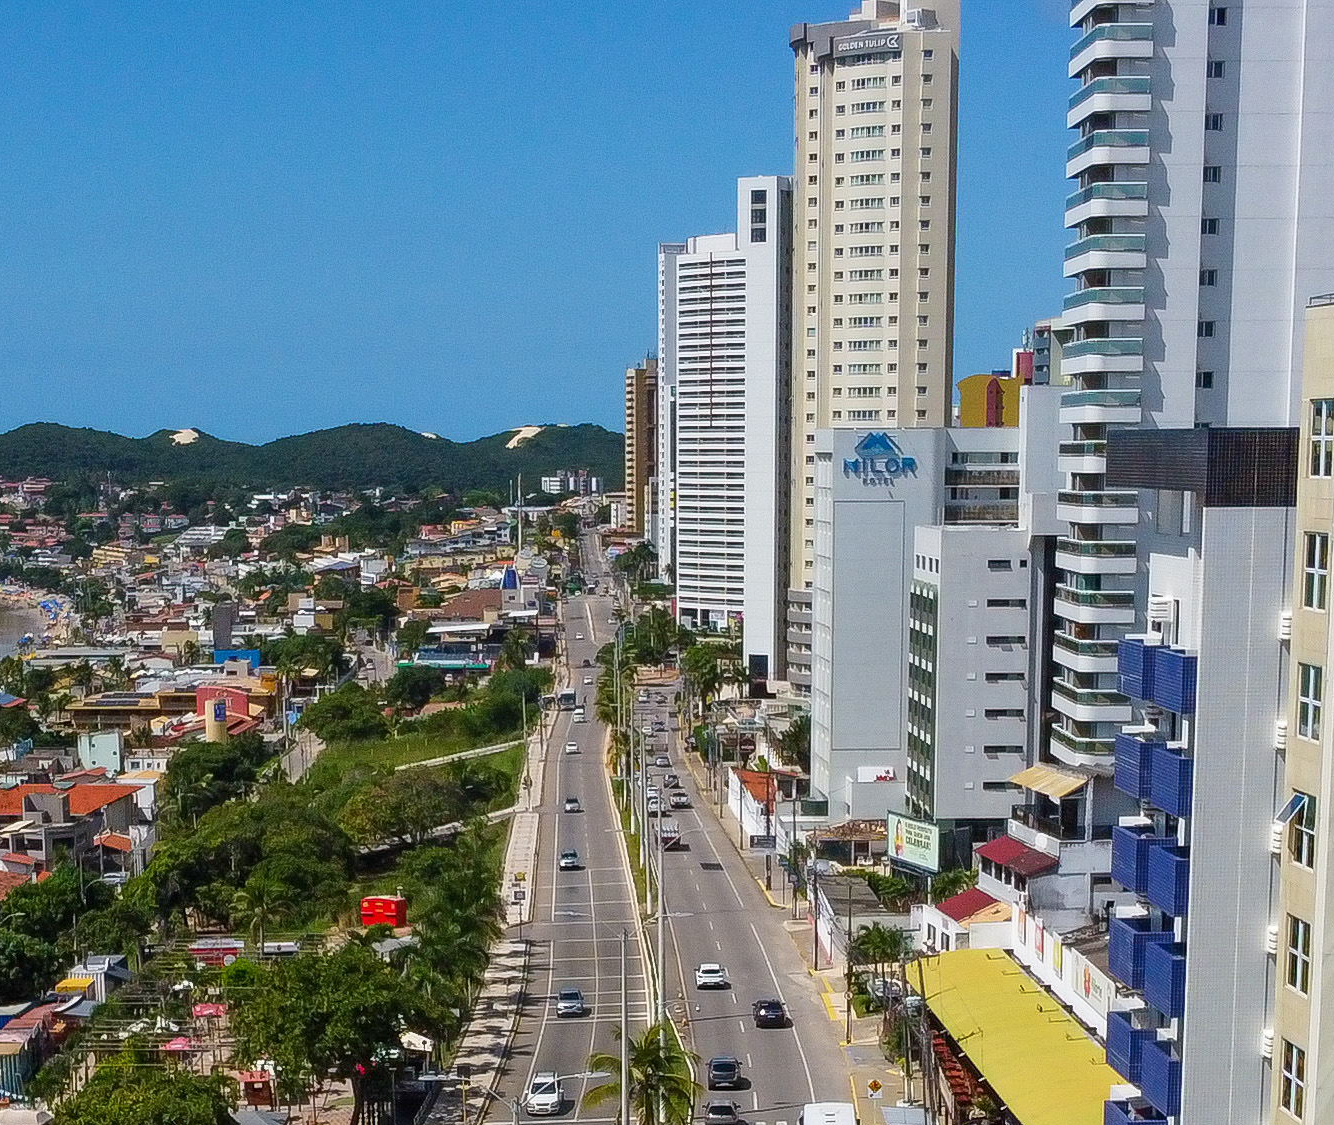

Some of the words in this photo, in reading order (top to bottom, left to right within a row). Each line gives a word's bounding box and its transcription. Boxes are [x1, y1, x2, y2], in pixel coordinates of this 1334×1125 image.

[838, 42, 864, 52] GOLDEN
[865, 39, 886, 49] TULIP
[862, 477, 895, 487] HOTEL
